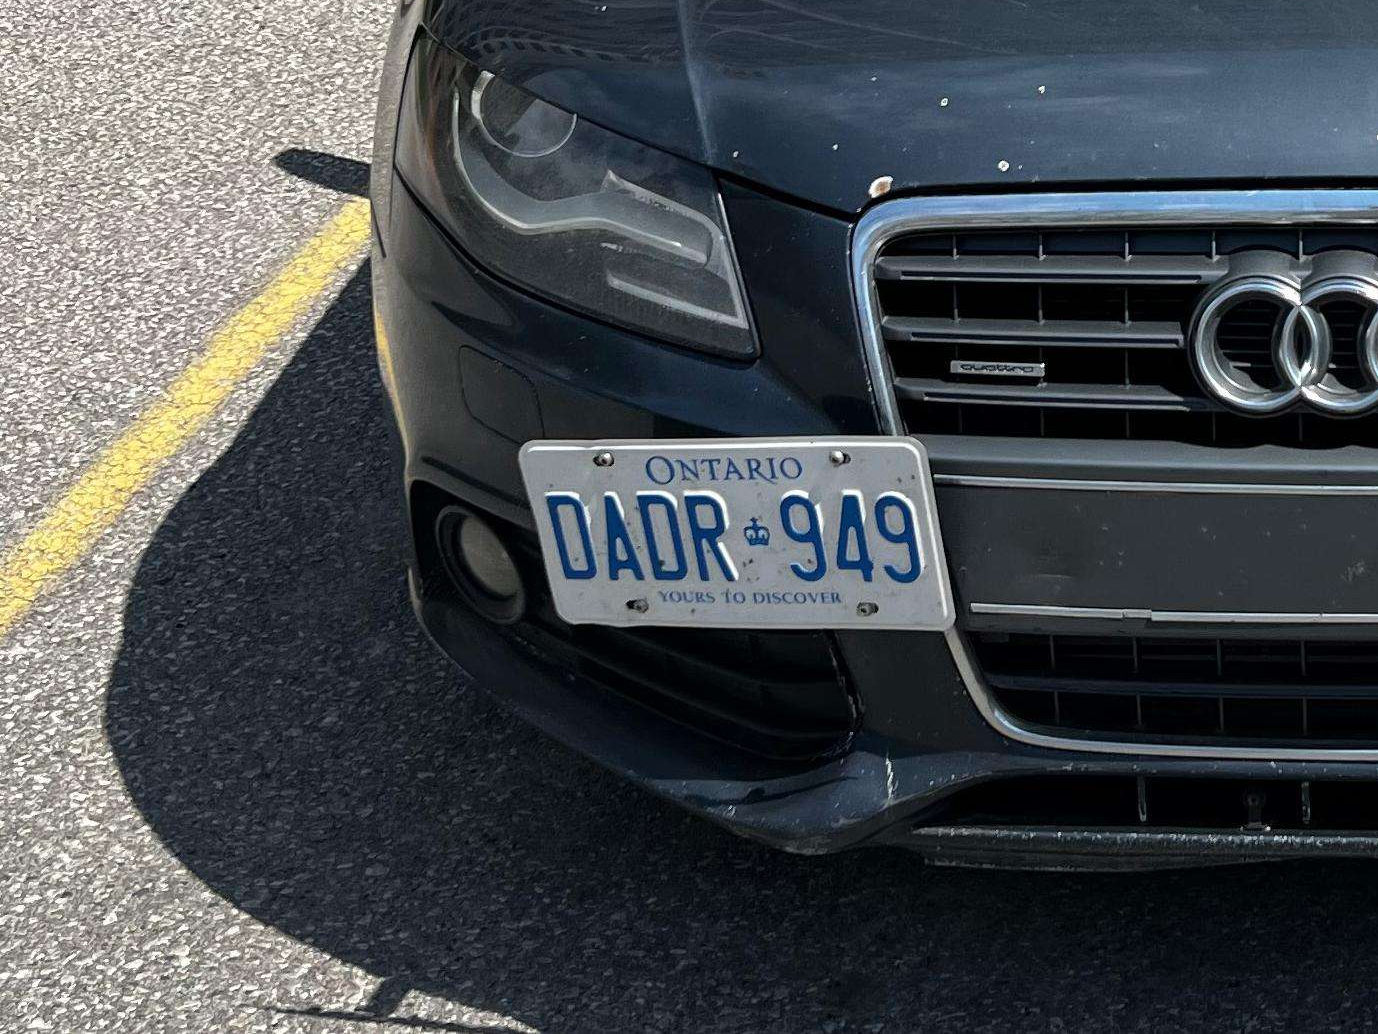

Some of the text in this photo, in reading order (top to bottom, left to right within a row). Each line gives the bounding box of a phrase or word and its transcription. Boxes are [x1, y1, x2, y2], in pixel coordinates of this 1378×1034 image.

[644, 454, 803, 485] ONTARIO
[545, 490, 925, 583] DADR 949
[658, 589, 842, 605] YOURS TO DISCOVER
